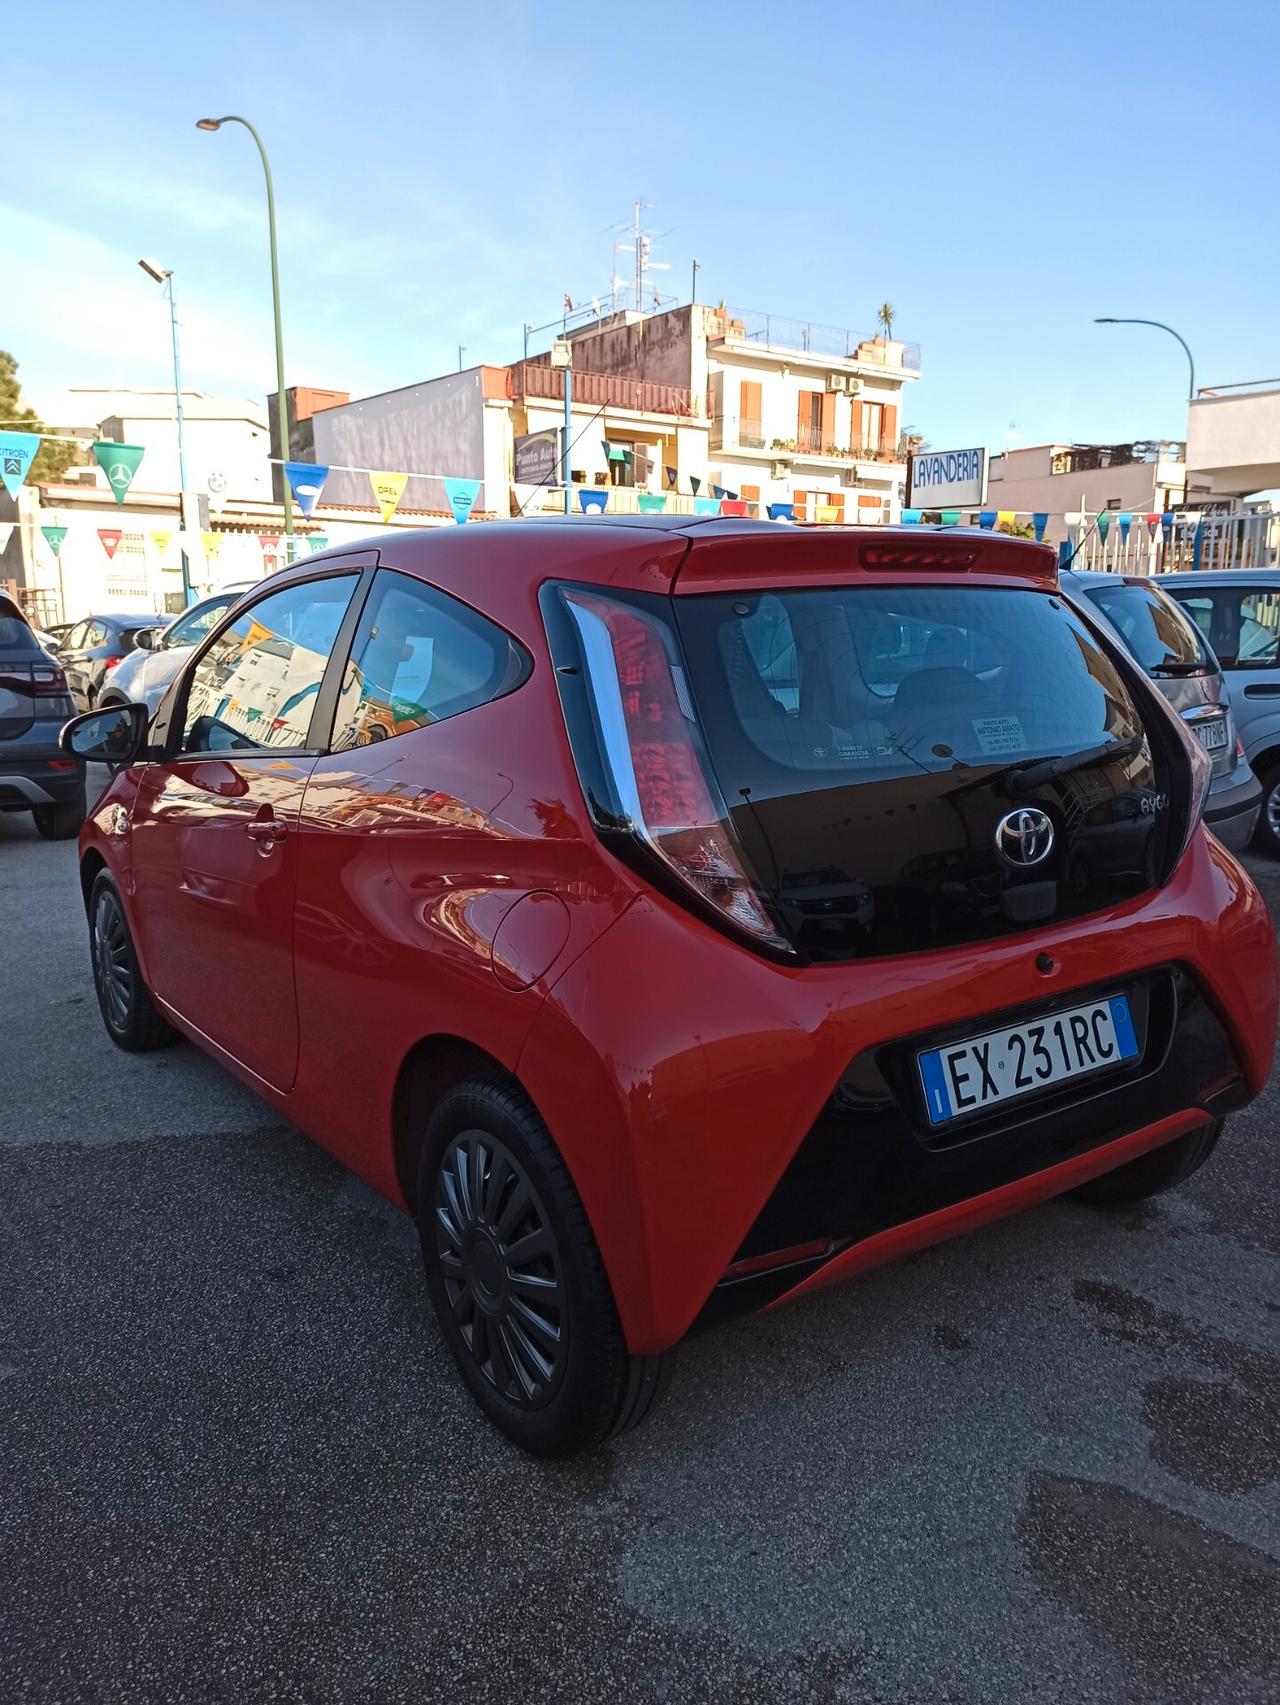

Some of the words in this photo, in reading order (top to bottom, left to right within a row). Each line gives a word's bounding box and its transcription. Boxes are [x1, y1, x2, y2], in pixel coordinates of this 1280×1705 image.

[516, 450, 538, 466] Punto
[913, 450, 979, 488] LAVANDERIA
[378, 486, 397, 495] OPEL
[977, 726, 1001, 735] ANTONIO
[947, 1042, 1000, 1109] EX
[1008, 1009, 1114, 1089] 231RC
